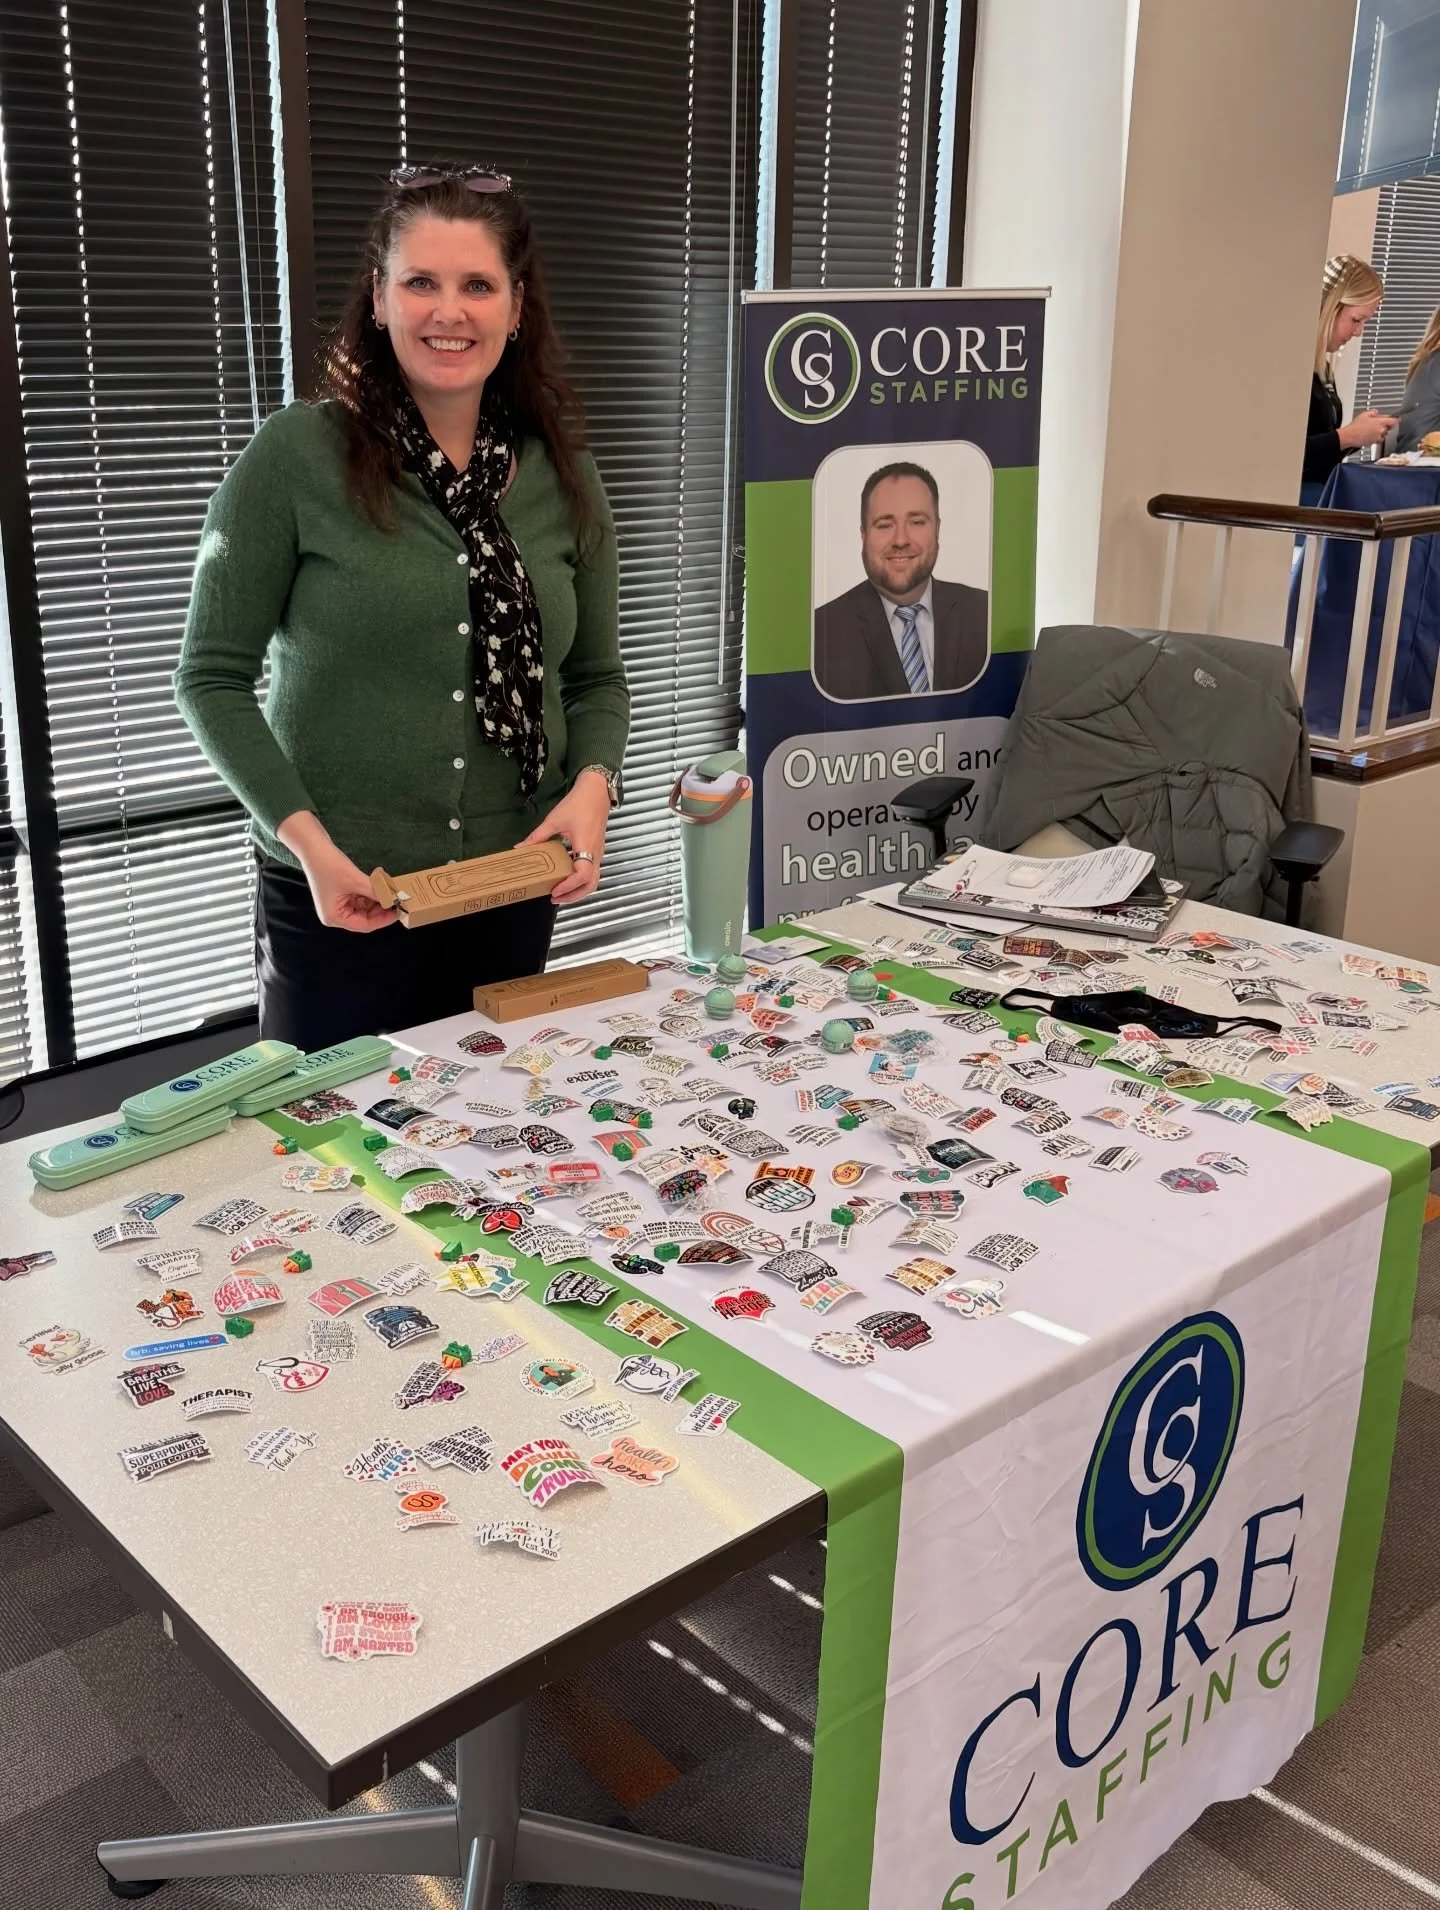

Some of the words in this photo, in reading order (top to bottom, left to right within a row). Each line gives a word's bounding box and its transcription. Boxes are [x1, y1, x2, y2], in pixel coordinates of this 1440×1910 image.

[870, 325, 1029, 377] CORE
[869, 377, 1029, 405] STAFFING
[782, 732, 946, 790] Owned
[195, 1054, 247, 1080] CORE
[565, 1068, 620, 1085] excuses
[747, 1180, 805, 1208] NIGHT
[764, 1186, 816, 1213] SHIFT
[207, 1198, 250, 1226] BECAUSE
[228, 1219, 246, 1236] JOB
[243, 1206, 269, 1222] TITLE
[510, 1228, 533, 1242] SOME
[514, 1231, 536, 1247] THINK
[984, 1234, 1018, 1260] BECAUSE
[136, 1247, 201, 1265] RESPIRATORY
[151, 1253, 197, 1270] THERAPIST
[1007, 1257, 1023, 1273] JOB
[1020, 1243, 1039, 1259] TITLE
[711, 1292, 769, 1313] HEALTHCARE
[719, 1299, 776, 1320] HEROES
[74, 1349, 105, 1367] goose
[153, 1341, 186, 1354] saving
[132, 1379, 162, 1395] LIVE.
[405, 1361, 441, 1398] RESPIRATORY
[181, 1388, 253, 1407] THERAPIST
[690, 1393, 715, 1419] SUPPORT
[691, 1397, 729, 1433] HEALTHCARE
[128, 1436, 207, 1470] SUPERPOWERS
[246, 1440, 258, 1449] TO
[258, 1431, 270, 1441] ALL
[249, 1426, 289, 1461] HEALTHCARE
[264, 1432, 297, 1460] WORKERS
[267, 1448, 298, 1472] Thank
[290, 1431, 317, 1448] You
[440, 1435, 492, 1460] THERAPIST
[614, 1437, 671, 1468] health
[139, 1459, 166, 1475] POUR
[167, 1446, 206, 1467] COFFEE
[378, 1448, 412, 1481] HERO
[427, 1440, 491, 1472] RESPIRATORY
[500, 1444, 534, 1471] MAY
[509, 1450, 581, 1482] DELULU
[593, 1455, 656, 1481] hero
[525, 1542, 539, 1553] EST.
[541, 1548, 558, 1558] 2020
[337, 1614, 359, 1624] AM
[363, 1616, 411, 1631] LOVED
[361, 1609, 409, 1622] ENOUGH
[335, 1624, 356, 1637] AM
[358, 1625, 412, 1640] STRONG
[333, 1638, 354, 1653] AM
[358, 1638, 414, 1653] WANTED
[949, 1493, 1305, 1846] CORE
